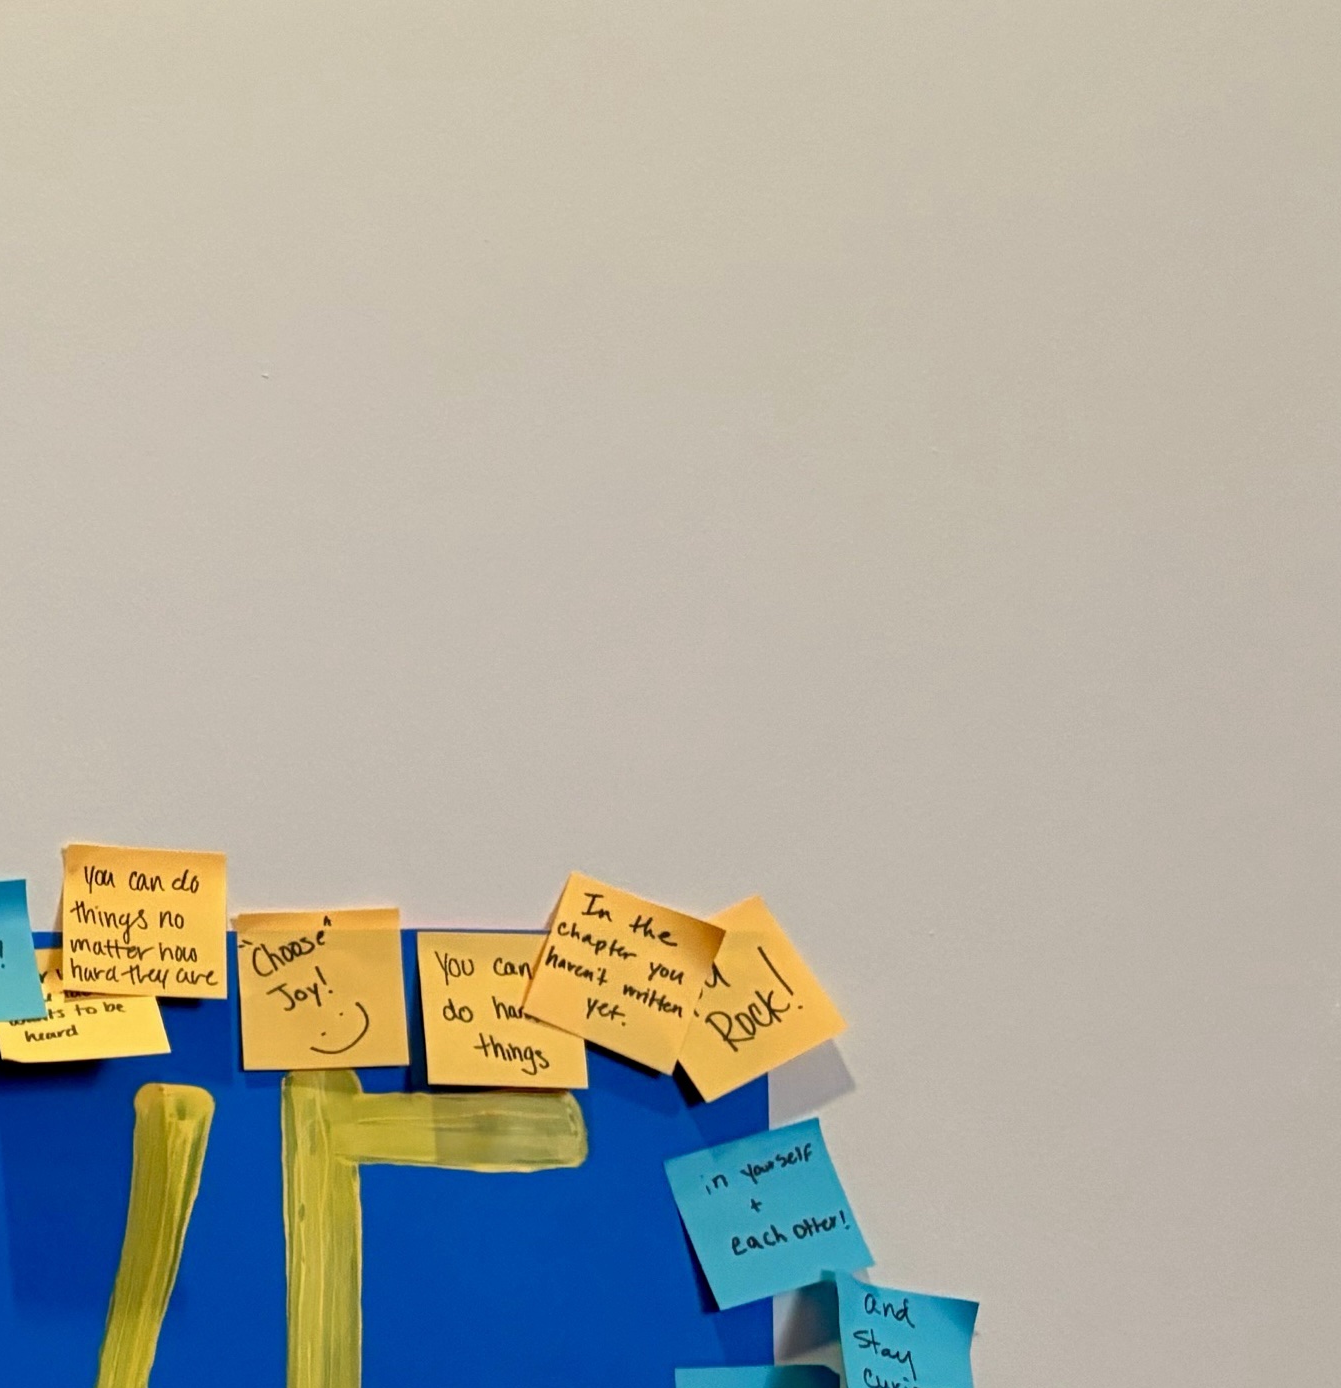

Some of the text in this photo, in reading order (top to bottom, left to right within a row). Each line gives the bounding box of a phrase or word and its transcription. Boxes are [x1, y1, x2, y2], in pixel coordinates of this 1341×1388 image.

[129, 869, 200, 894] can do
[70, 900, 148, 944] things
[583, 892, 613, 922] In
[70, 939, 198, 963] matter how
[557, 921, 637, 961] chapter
[649, 962, 684, 986] you
[70, 963, 118, 984] hard
[121, 965, 166, 992] they
[266, 966, 333, 1012] Joy!
[544, 946, 683, 1018] haven't written
[585, 997, 626, 1026] yet.
[705, 946, 805, 1052] Rock!
[25, 1027, 78, 1043] heard
[474, 1033, 550, 1076] things
[741, 1143, 813, 1183] yourself
[732, 1227, 787, 1256] each
